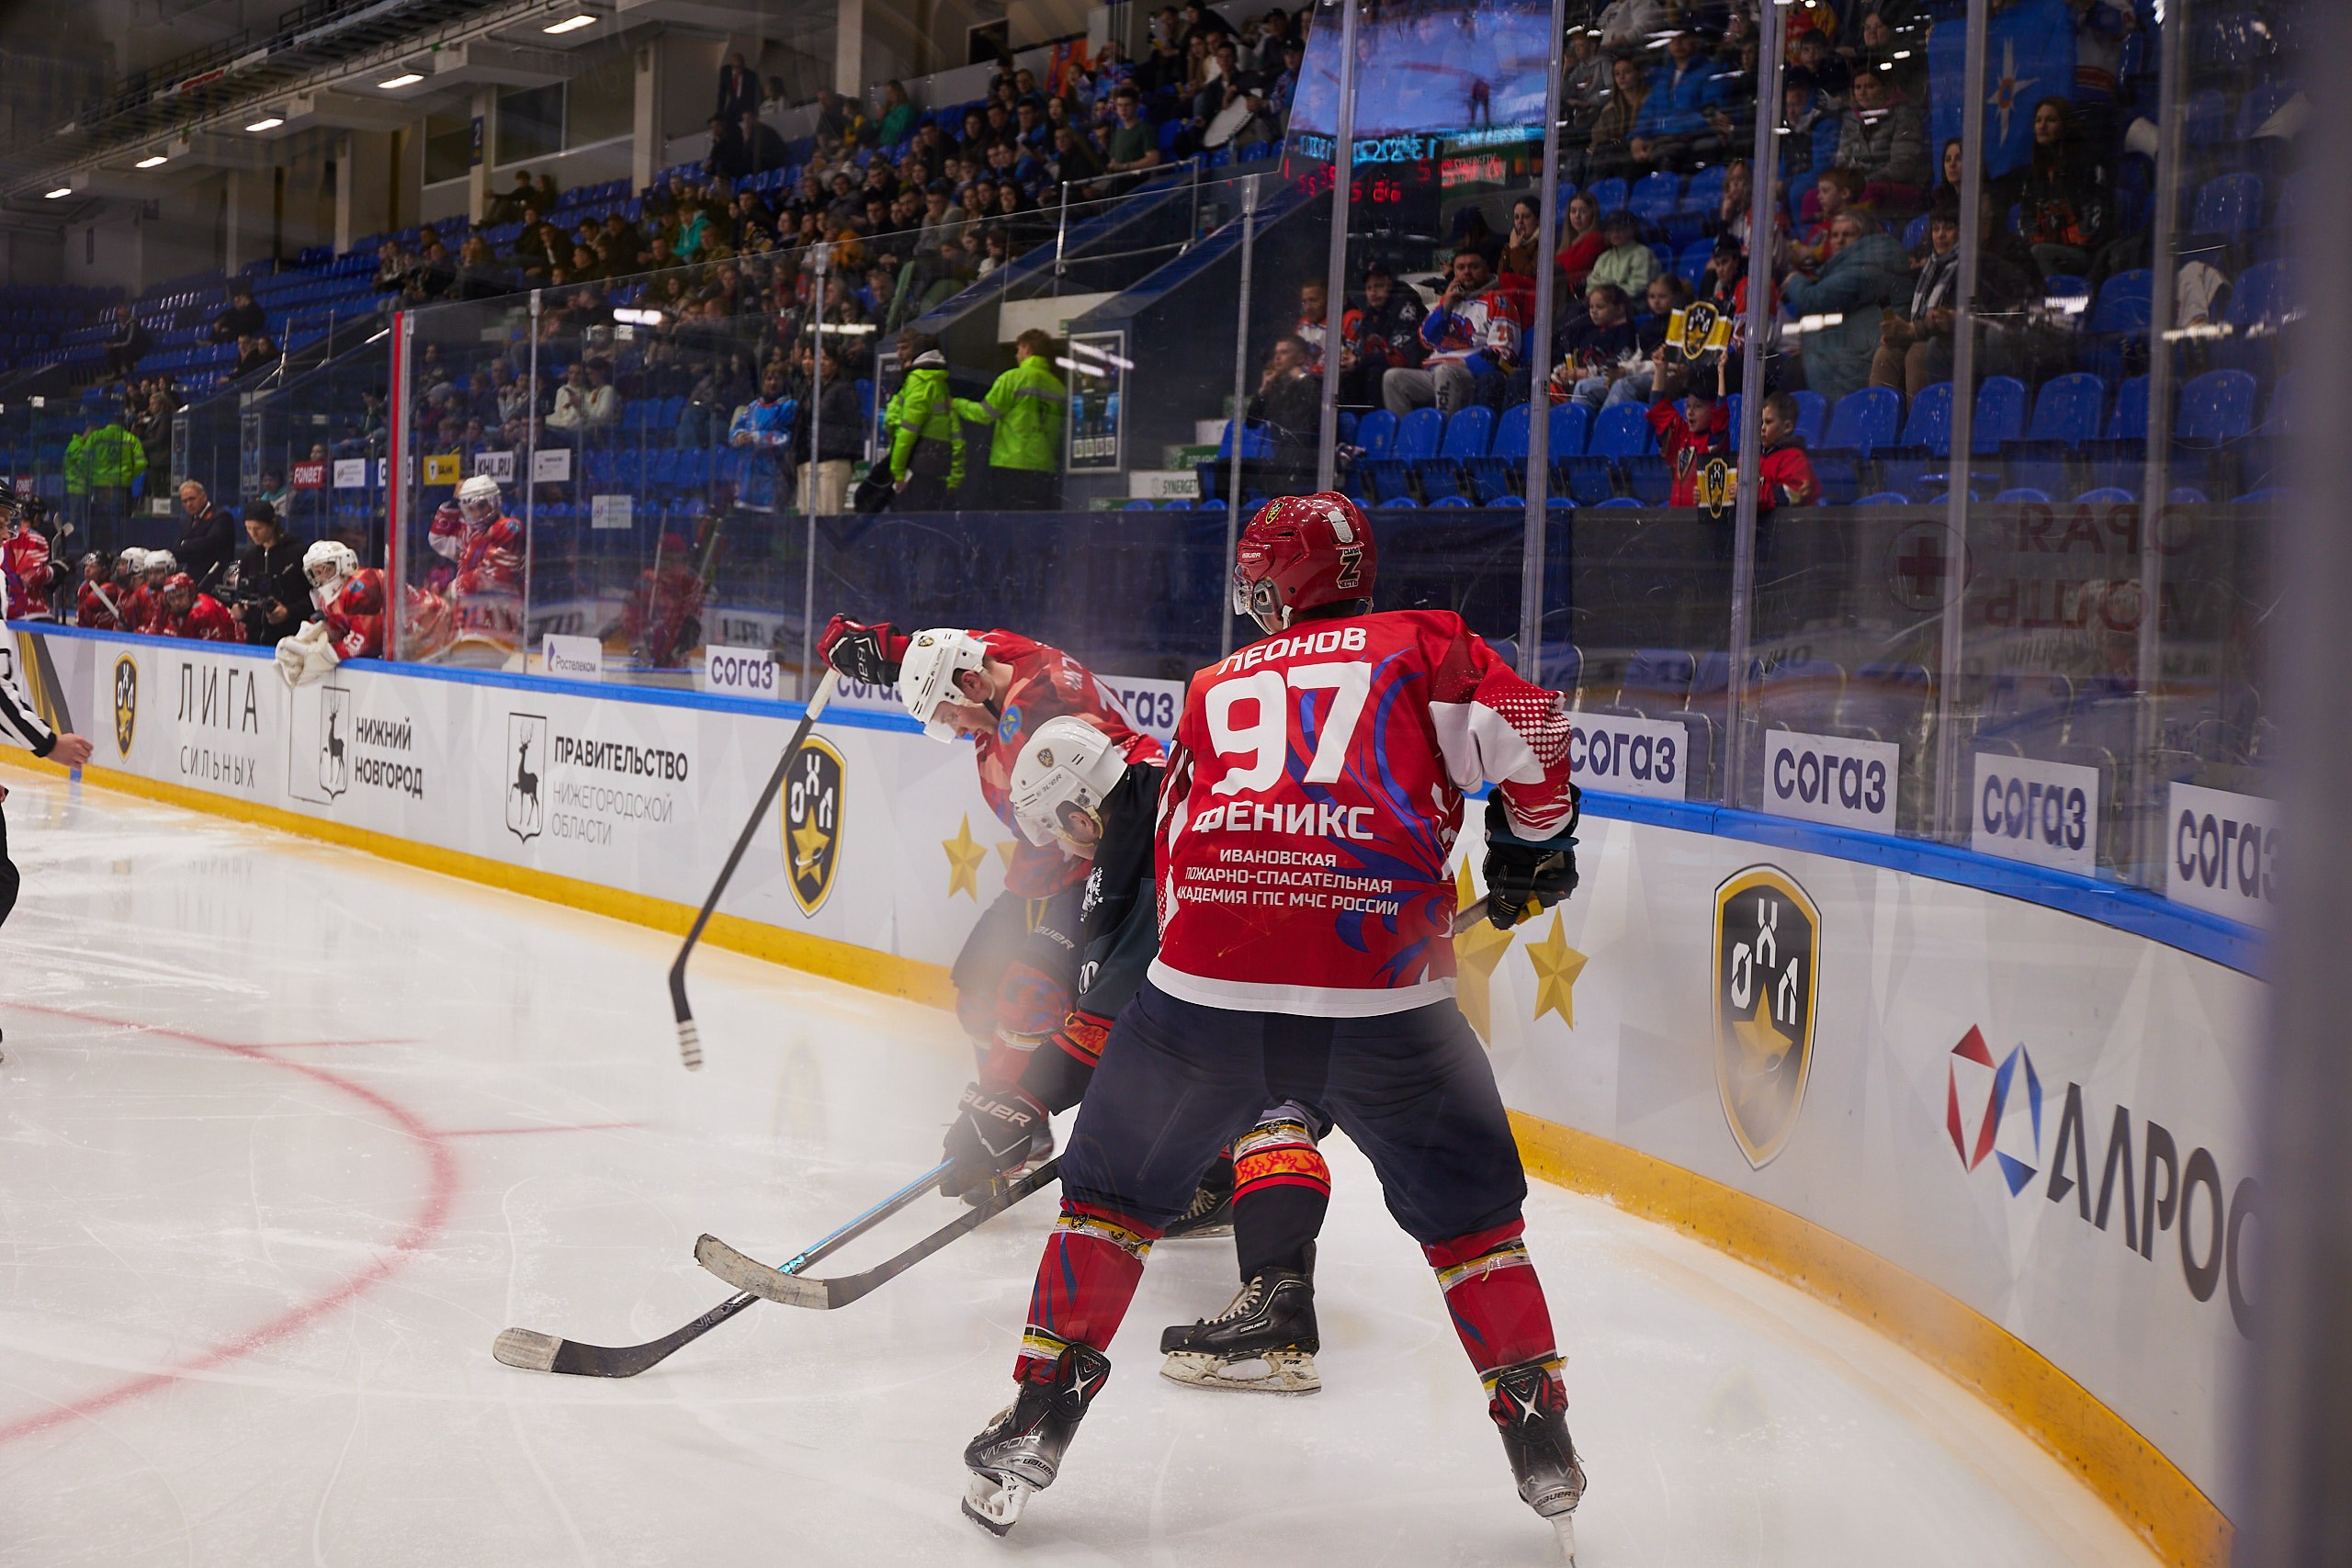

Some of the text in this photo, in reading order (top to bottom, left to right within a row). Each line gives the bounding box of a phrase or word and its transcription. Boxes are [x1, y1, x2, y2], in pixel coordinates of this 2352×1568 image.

[293, 466, 323, 483] FONBET
[477, 458, 511, 476] KHL.RU
[1163, 479, 1198, 495] SYNERGET
[1338, 553, 1363, 581] Z
[555, 656, 596, 673] Ростелеком
[1216, 626, 1367, 678] ЛЕОНОВ
[178, 662, 258, 734] ЛИГА
[356, 716, 412, 751] НИЖНИЙ
[1204, 661, 1373, 795] 97
[180, 745, 255, 789] СИЛЬНЫХ
[554, 735, 688, 782] ПРАВИТЕЛЬСТВО
[355, 756, 423, 800] НОВГОРОД
[553, 782, 673, 824] НИЖЕГОРОДСКОЙ
[552, 813, 612, 846] ОБЛАСТИ
[1191, 800, 1374, 840] ФЕНИКС
[1219, 849, 1337, 868] ИВАНОВСКАЯ
[1185, 866, 1393, 894] ПОЖАРНО-СПАСАТЕЛЬНАЯ
[1177, 886, 1399, 916] АКАДЕМИЯ ГПС МЧС РОССИИ
[2046, 1081, 2263, 1341] АЛРОС
[976, 1435, 1042, 1461] VAPOR
[1023, 1458, 1056, 1479] BAUER
